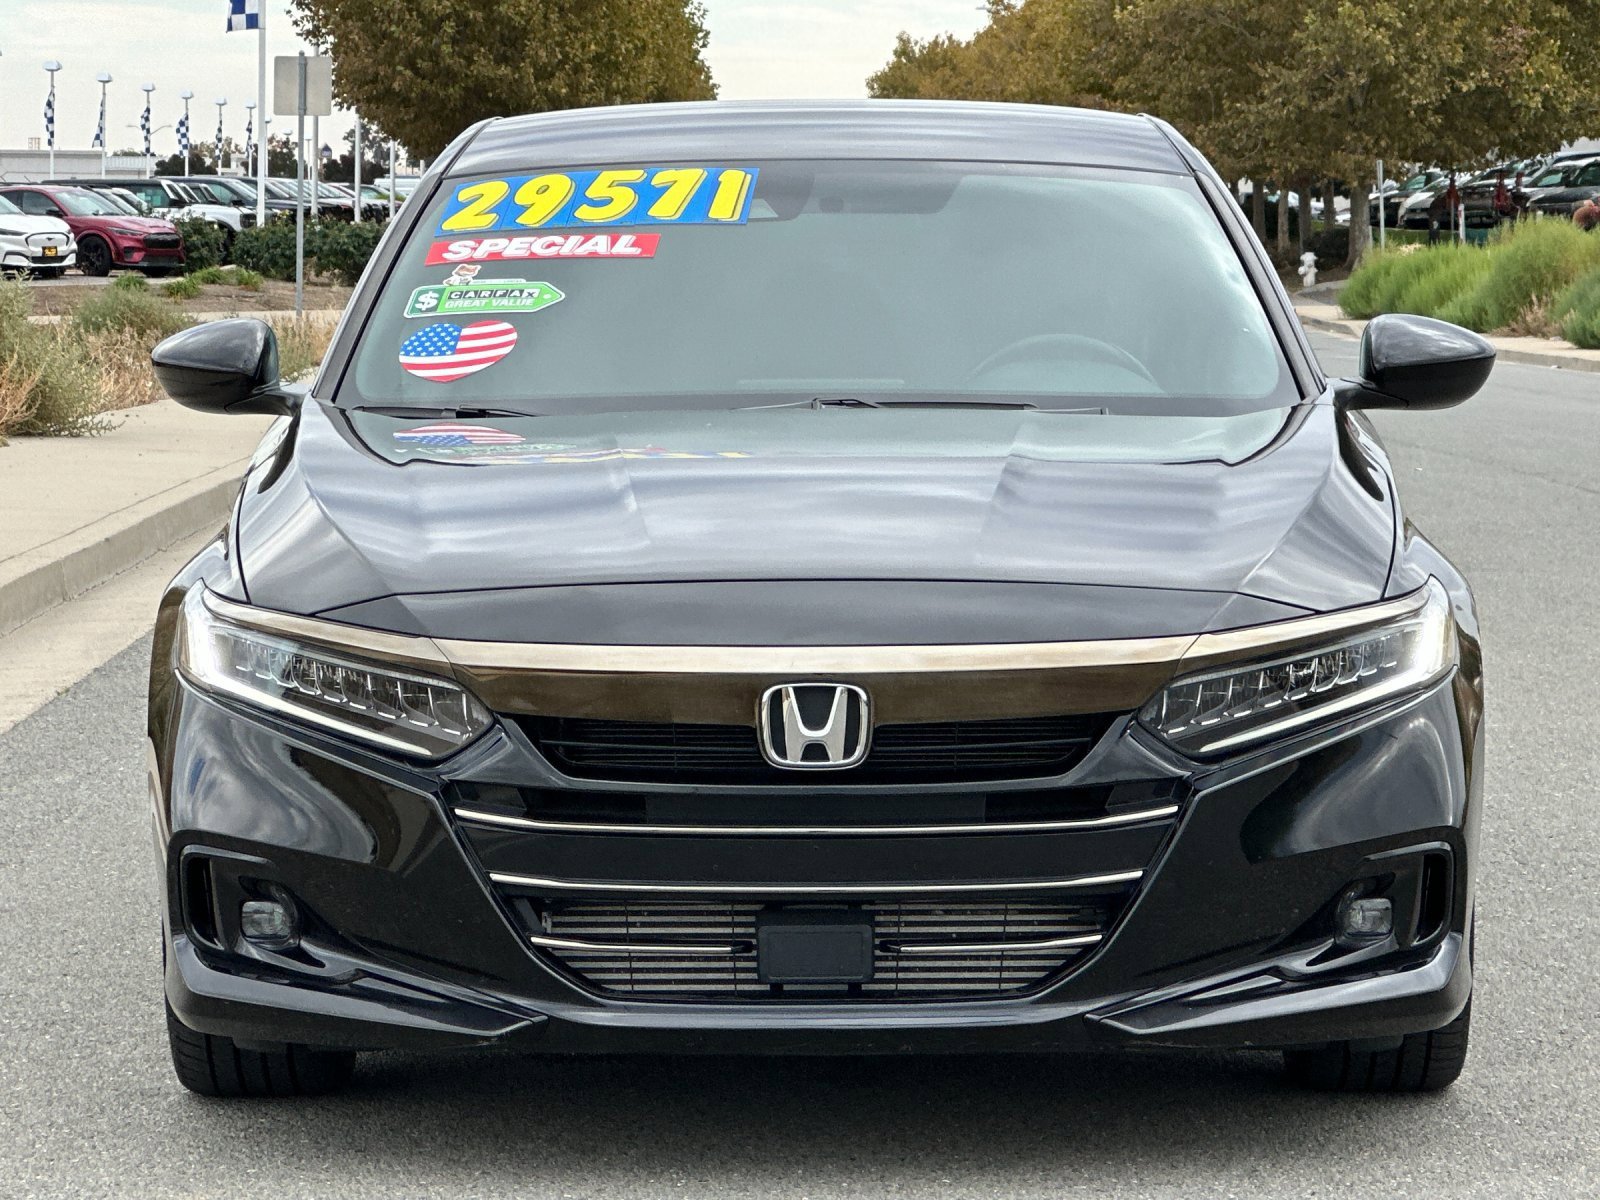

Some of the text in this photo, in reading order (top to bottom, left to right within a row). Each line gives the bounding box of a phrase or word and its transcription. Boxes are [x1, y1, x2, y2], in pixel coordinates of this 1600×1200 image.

[441, 169, 752, 231] 29571
[442, 235, 642, 261] SPECIAL
[448, 288, 541, 299] CARFAX
[444, 298, 534, 309] GREAT VALUE
